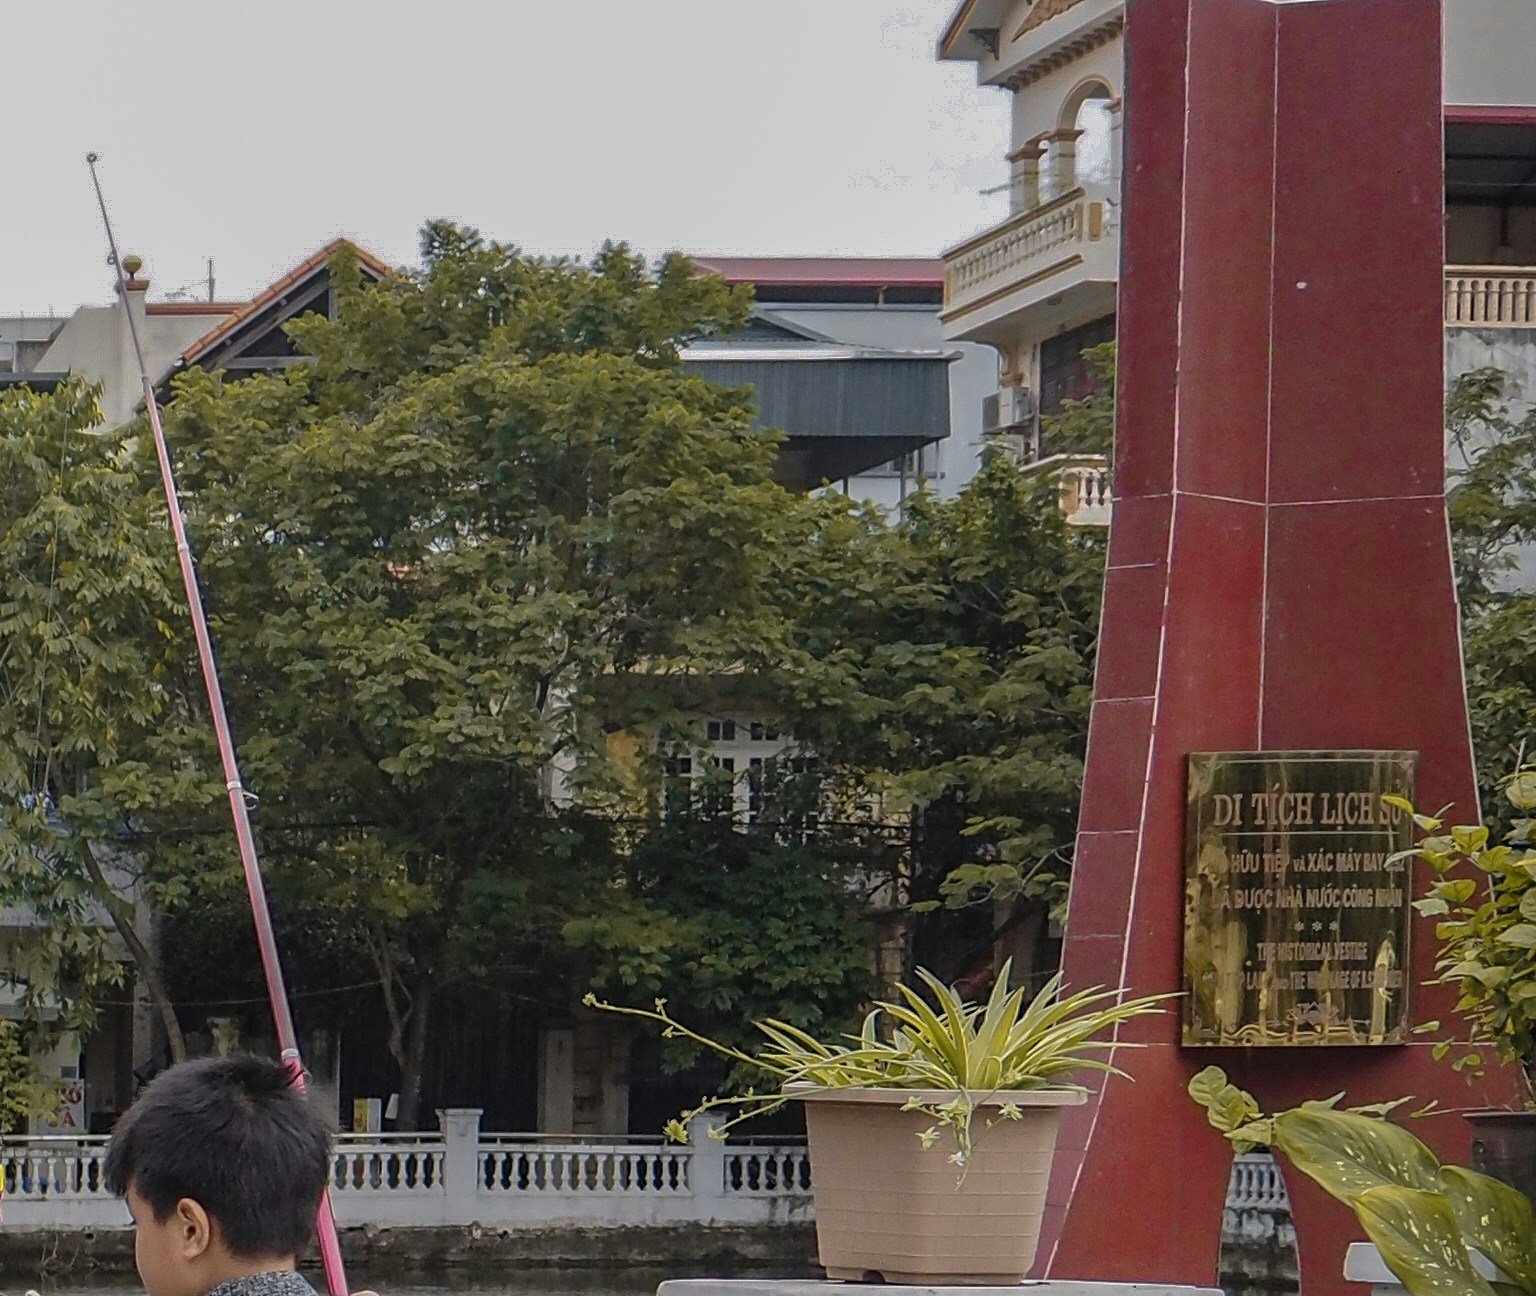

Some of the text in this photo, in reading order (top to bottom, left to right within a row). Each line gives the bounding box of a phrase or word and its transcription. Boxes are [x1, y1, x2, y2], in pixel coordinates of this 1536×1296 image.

[1212, 793, 1243, 827] DI
[1251, 782, 1314, 826] TÍCH
[1320, 791, 1375, 832] LỊCH
